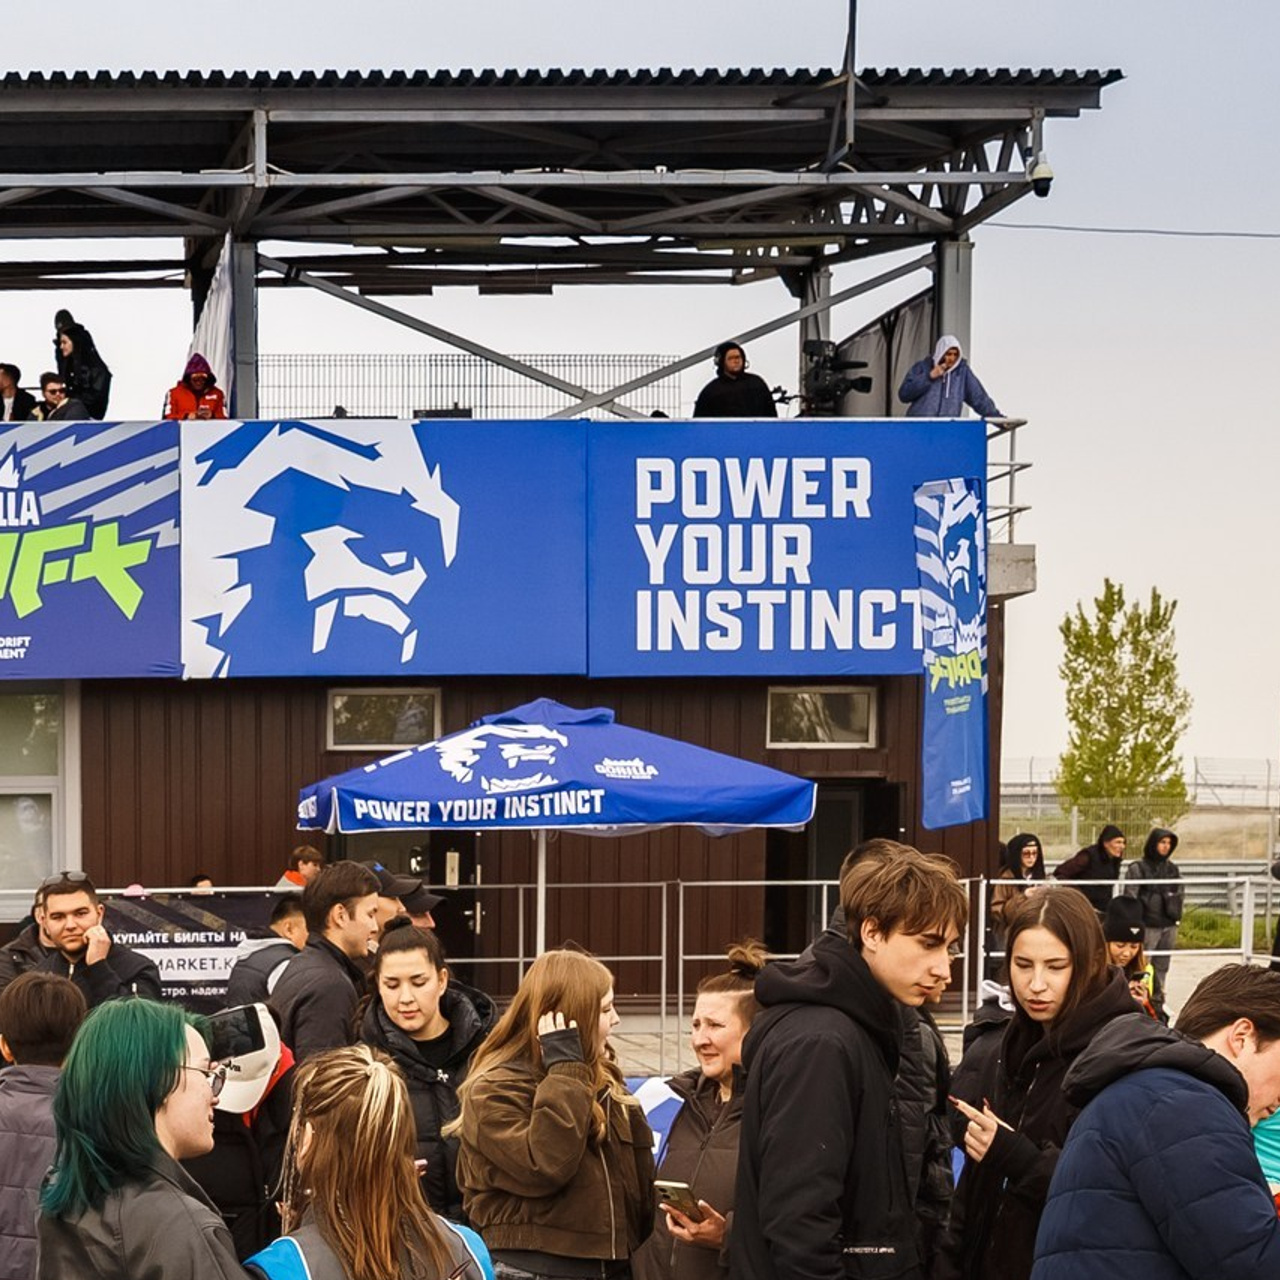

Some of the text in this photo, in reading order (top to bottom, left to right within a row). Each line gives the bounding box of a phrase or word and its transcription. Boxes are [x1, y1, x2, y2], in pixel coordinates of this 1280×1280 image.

[636, 457, 871, 518] POWER
[634, 524, 812, 584] YOUR
[636, 589, 923, 651] INSTINCT
[354, 789, 605, 823] POWER YOUR INSTINCT
[174, 932, 224, 943] БИЛЕТЫ
[230, 931, 247, 942] НА
